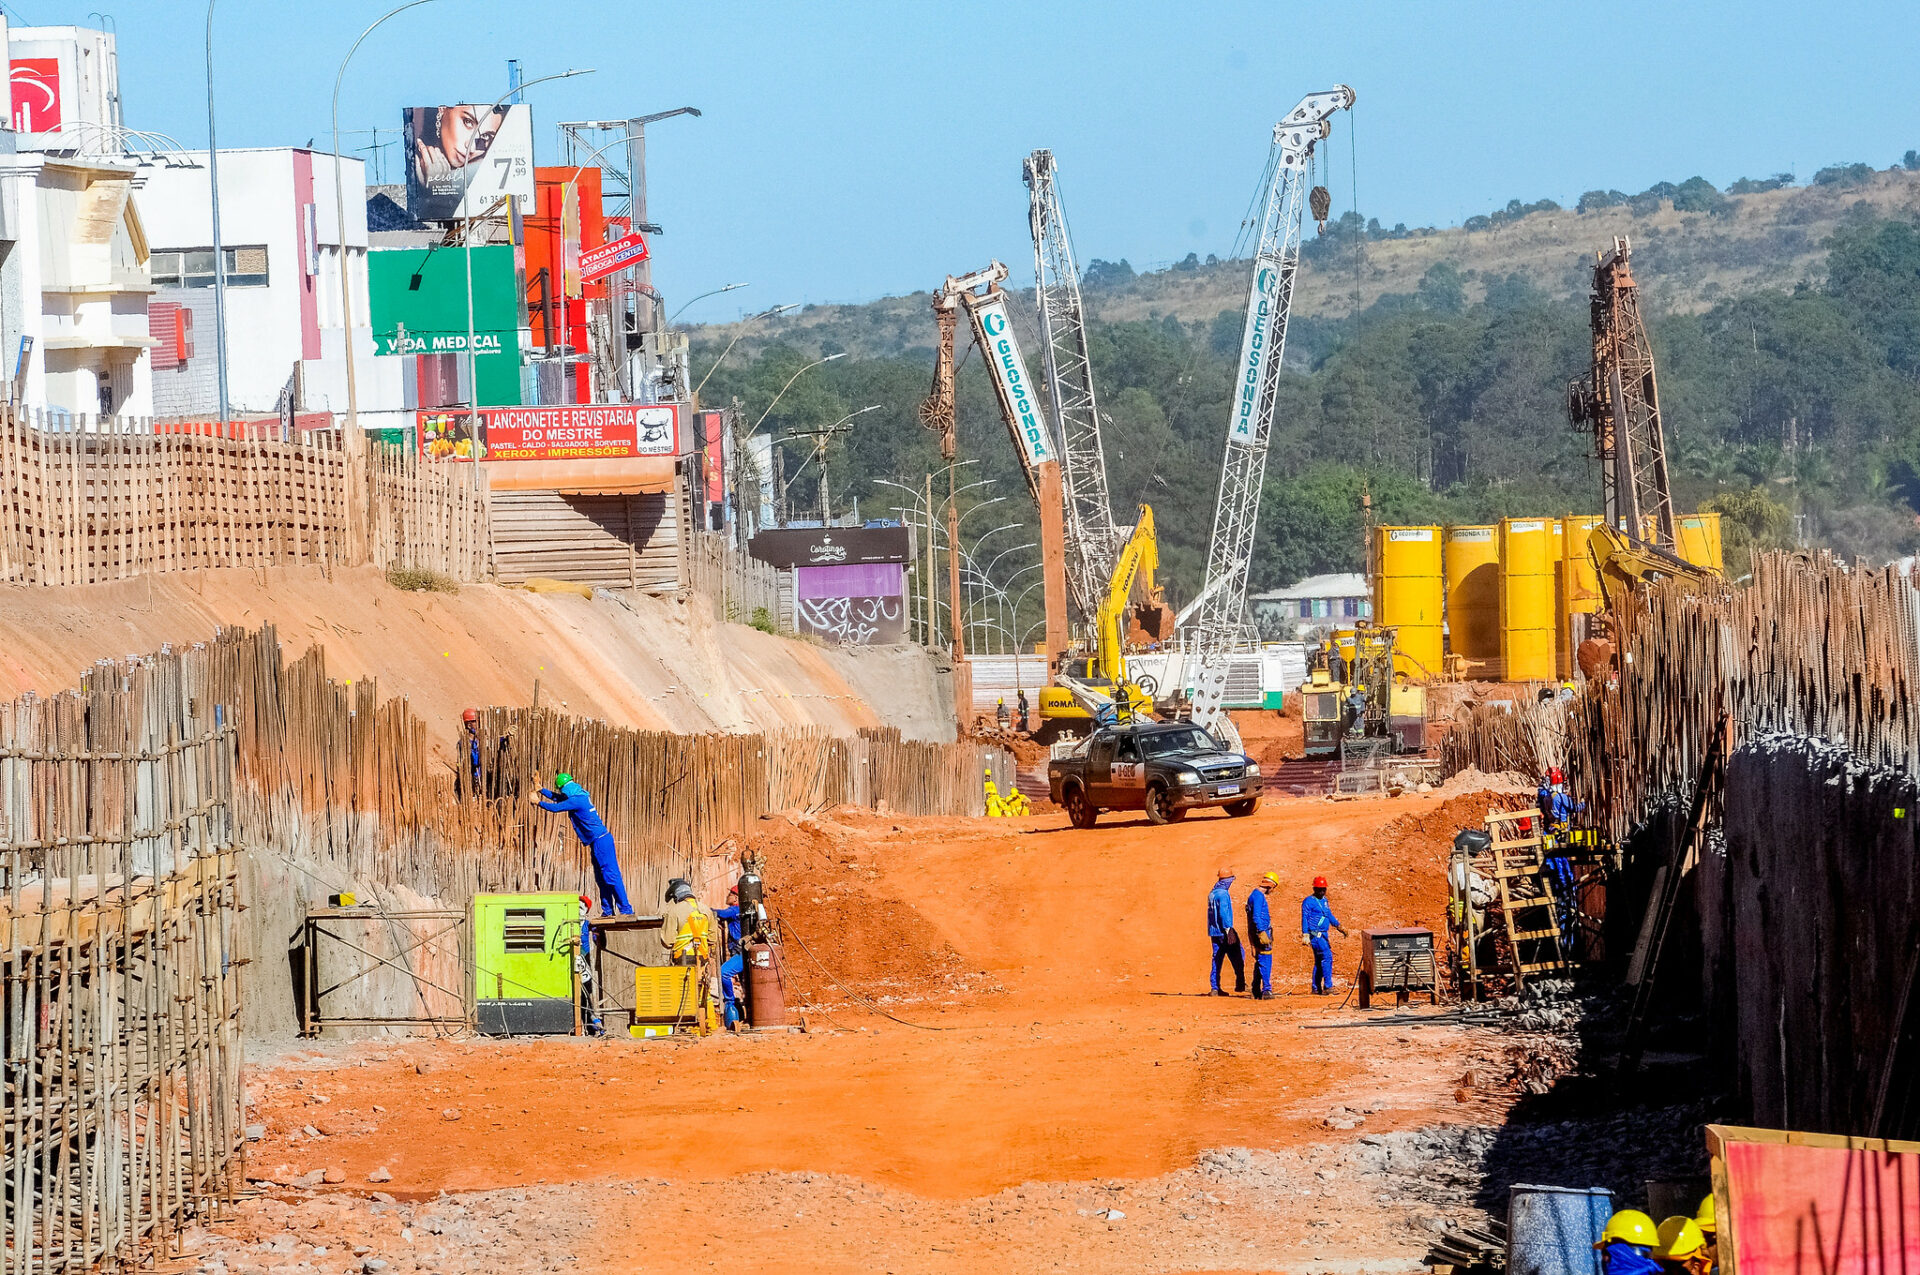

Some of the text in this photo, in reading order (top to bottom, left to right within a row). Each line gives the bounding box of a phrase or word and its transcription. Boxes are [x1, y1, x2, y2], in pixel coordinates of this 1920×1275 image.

[493, 157, 512, 189] 7
[581, 240, 632, 266] ATACADÃO
[616, 244, 643, 262] CENTER
[387, 338, 427, 351] VDA
[432, 335, 502, 350] MEDICAL
[1236, 300, 1270, 436] GEOSONDA
[997, 338, 1047, 458] GEOSONDA
[487, 409, 635, 429] LANCHONETE E REVISTARIA
[522, 427, 603, 441] DO MESTRE
[490, 439, 631, 450] PASTEL CALDO SALGADOS SORVETES
[494, 446, 629, 459] XEROX IMPRESSÕES
